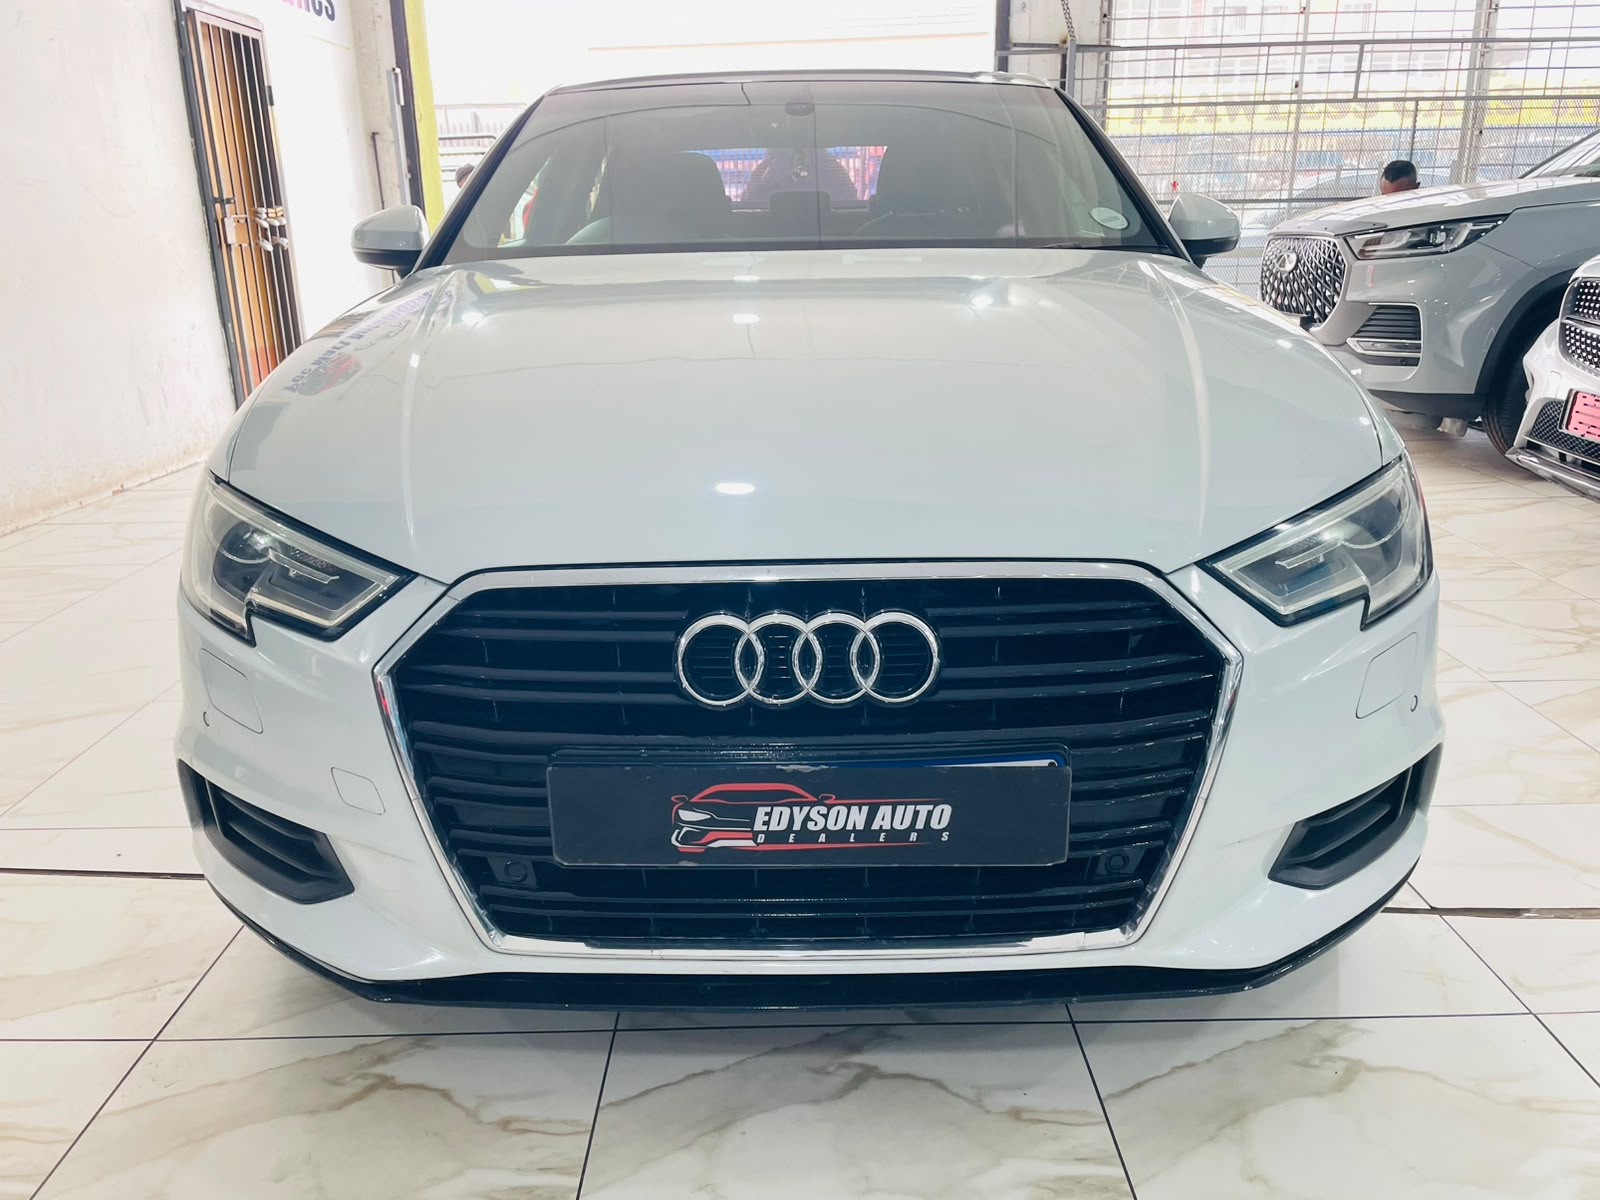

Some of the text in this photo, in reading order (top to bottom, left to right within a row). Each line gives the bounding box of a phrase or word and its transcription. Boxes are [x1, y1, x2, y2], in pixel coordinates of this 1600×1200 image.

[753, 804, 953, 831] EDYSON AUTO
[756, 831, 950, 843] DEALERS
